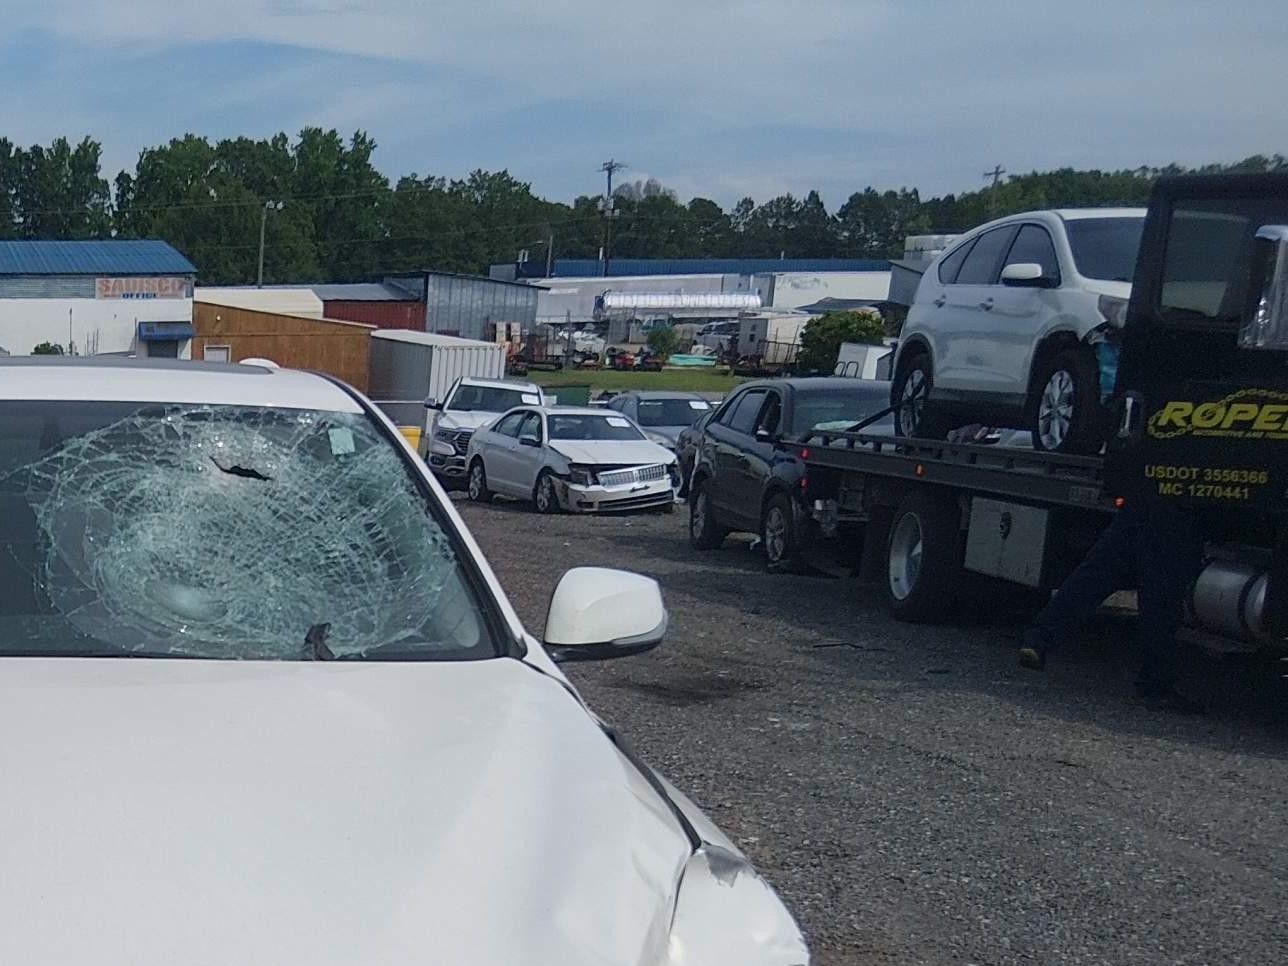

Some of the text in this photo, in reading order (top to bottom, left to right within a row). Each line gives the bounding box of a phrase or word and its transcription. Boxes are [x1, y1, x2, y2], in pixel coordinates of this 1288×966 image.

[1144, 465, 1199, 480] USDOT
[1158, 482, 1249, 499] MC 1270441
